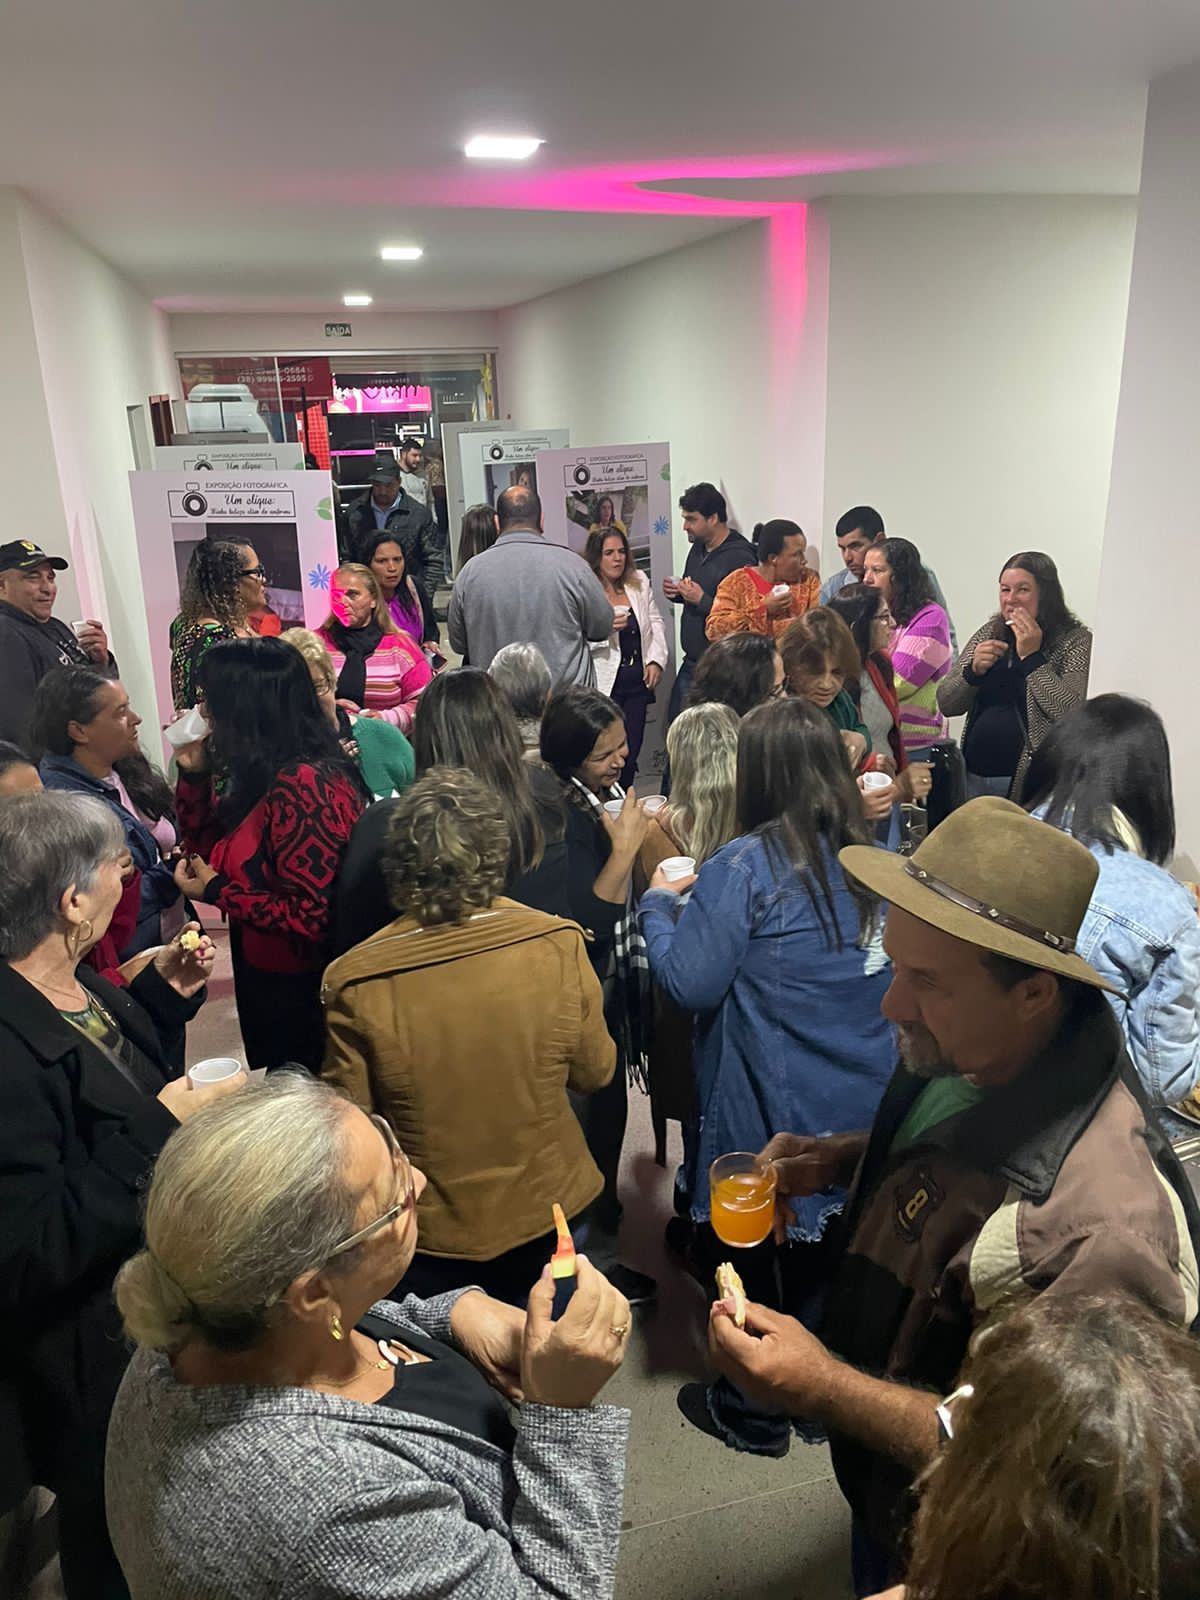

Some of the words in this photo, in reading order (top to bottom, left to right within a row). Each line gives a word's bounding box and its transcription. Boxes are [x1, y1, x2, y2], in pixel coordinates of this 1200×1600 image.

[326, 325, 351, 337] SAÍDA
[205, 481, 242, 489] EXPOSIÇÃO
[224, 493, 242, 505] Um
